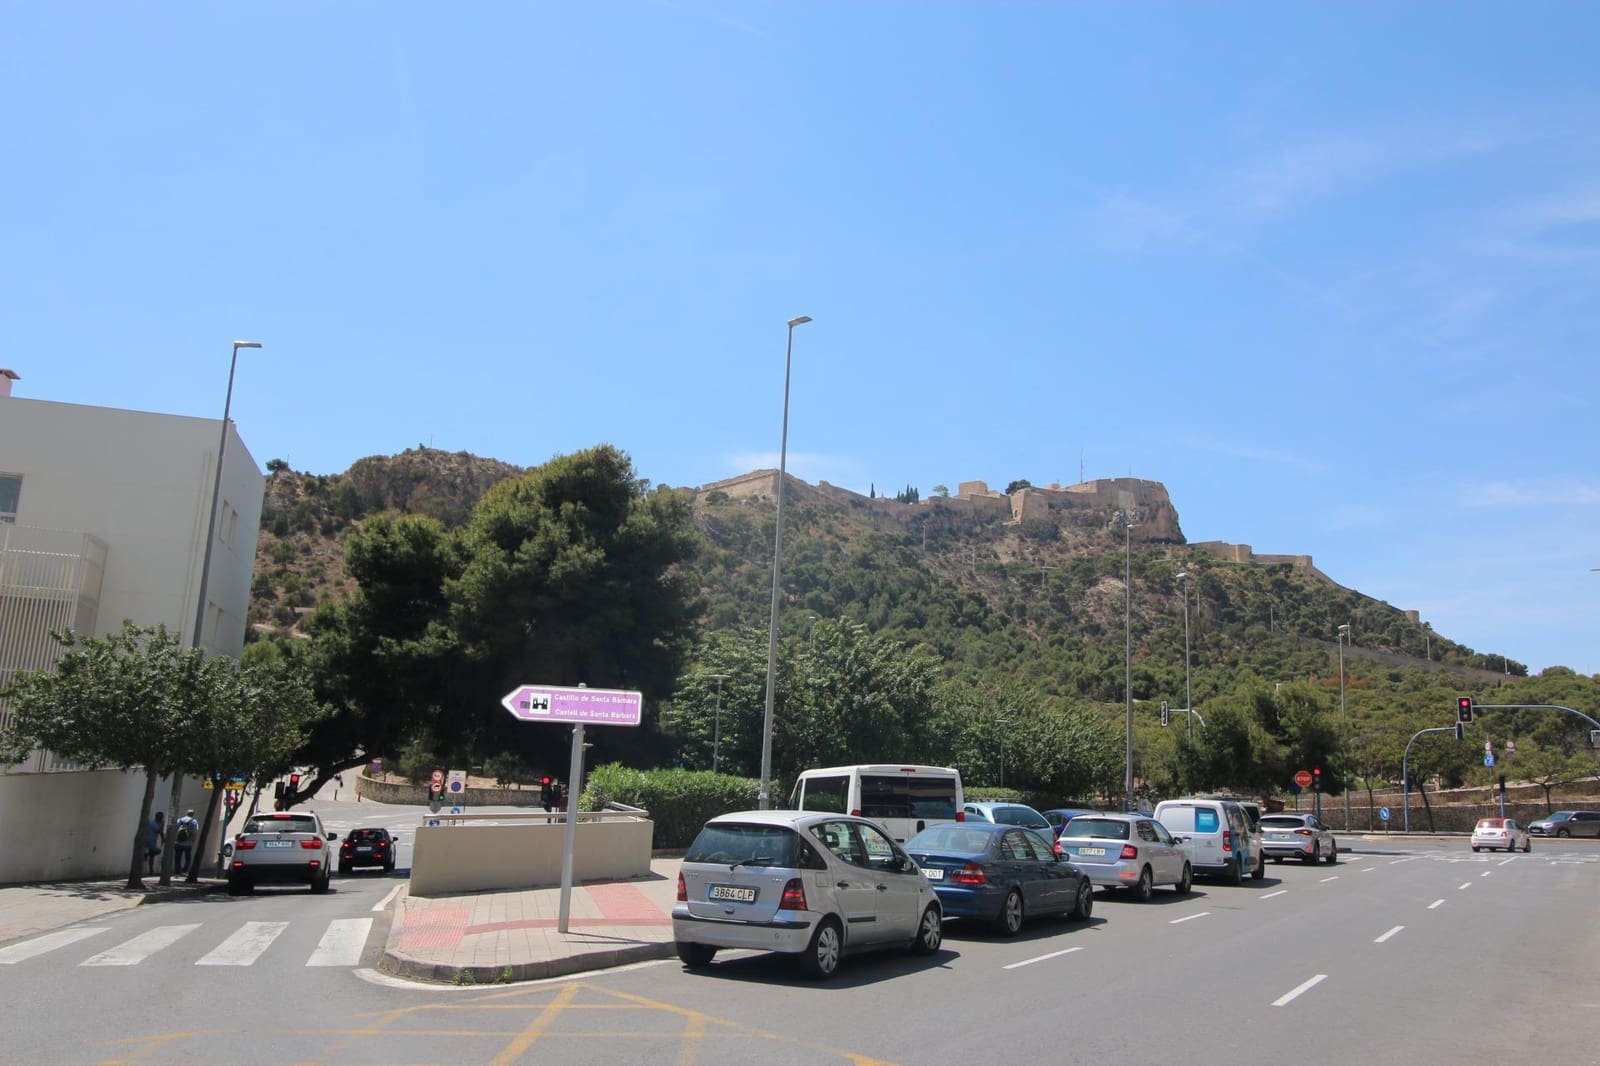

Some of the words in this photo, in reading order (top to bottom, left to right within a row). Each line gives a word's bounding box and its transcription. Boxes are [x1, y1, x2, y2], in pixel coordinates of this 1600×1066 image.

[591, 695, 610, 703] Santa
[555, 708, 578, 716] Castell
[590, 710, 609, 718] Santa
[714, 887, 735, 898] 3864
[737, 889, 754, 900] CLP
